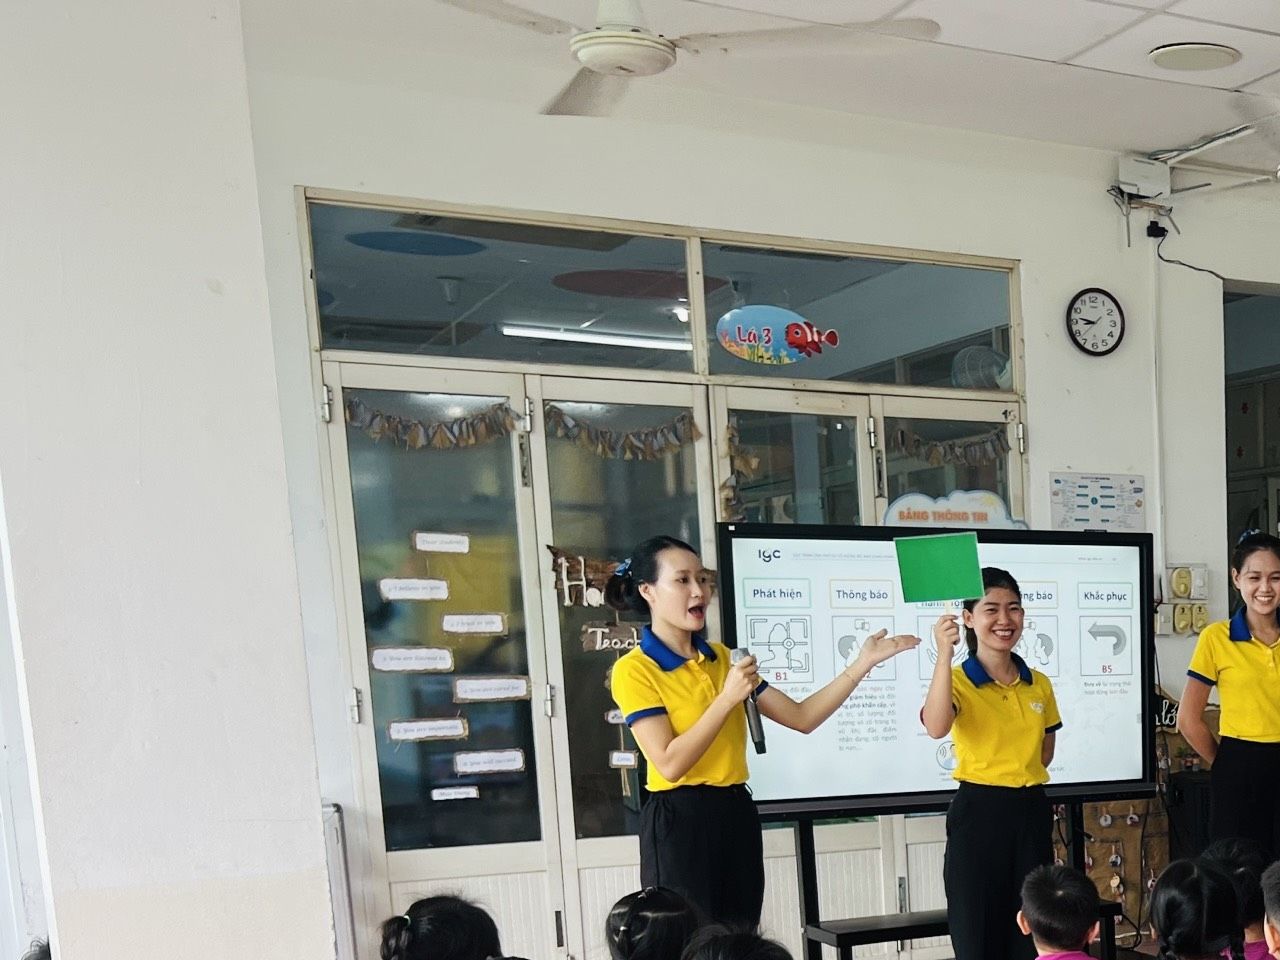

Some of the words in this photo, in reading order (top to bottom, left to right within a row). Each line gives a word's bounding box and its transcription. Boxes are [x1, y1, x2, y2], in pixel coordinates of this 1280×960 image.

[762, 327, 772, 345] 3
[753, 588, 776, 598] Phát
[779, 588, 802, 600] hiện
[836, 589, 867, 601] Thông
[870, 589, 888, 599] báo
[1036, 590, 1053, 600] báo
[1084, 590, 1104, 600] Khắc
[1107, 591, 1127, 602] phục
[1102, 664, 1112, 673] B5
[776, 672, 787, 680] B1
[1162, 700, 1177, 725] lớ
